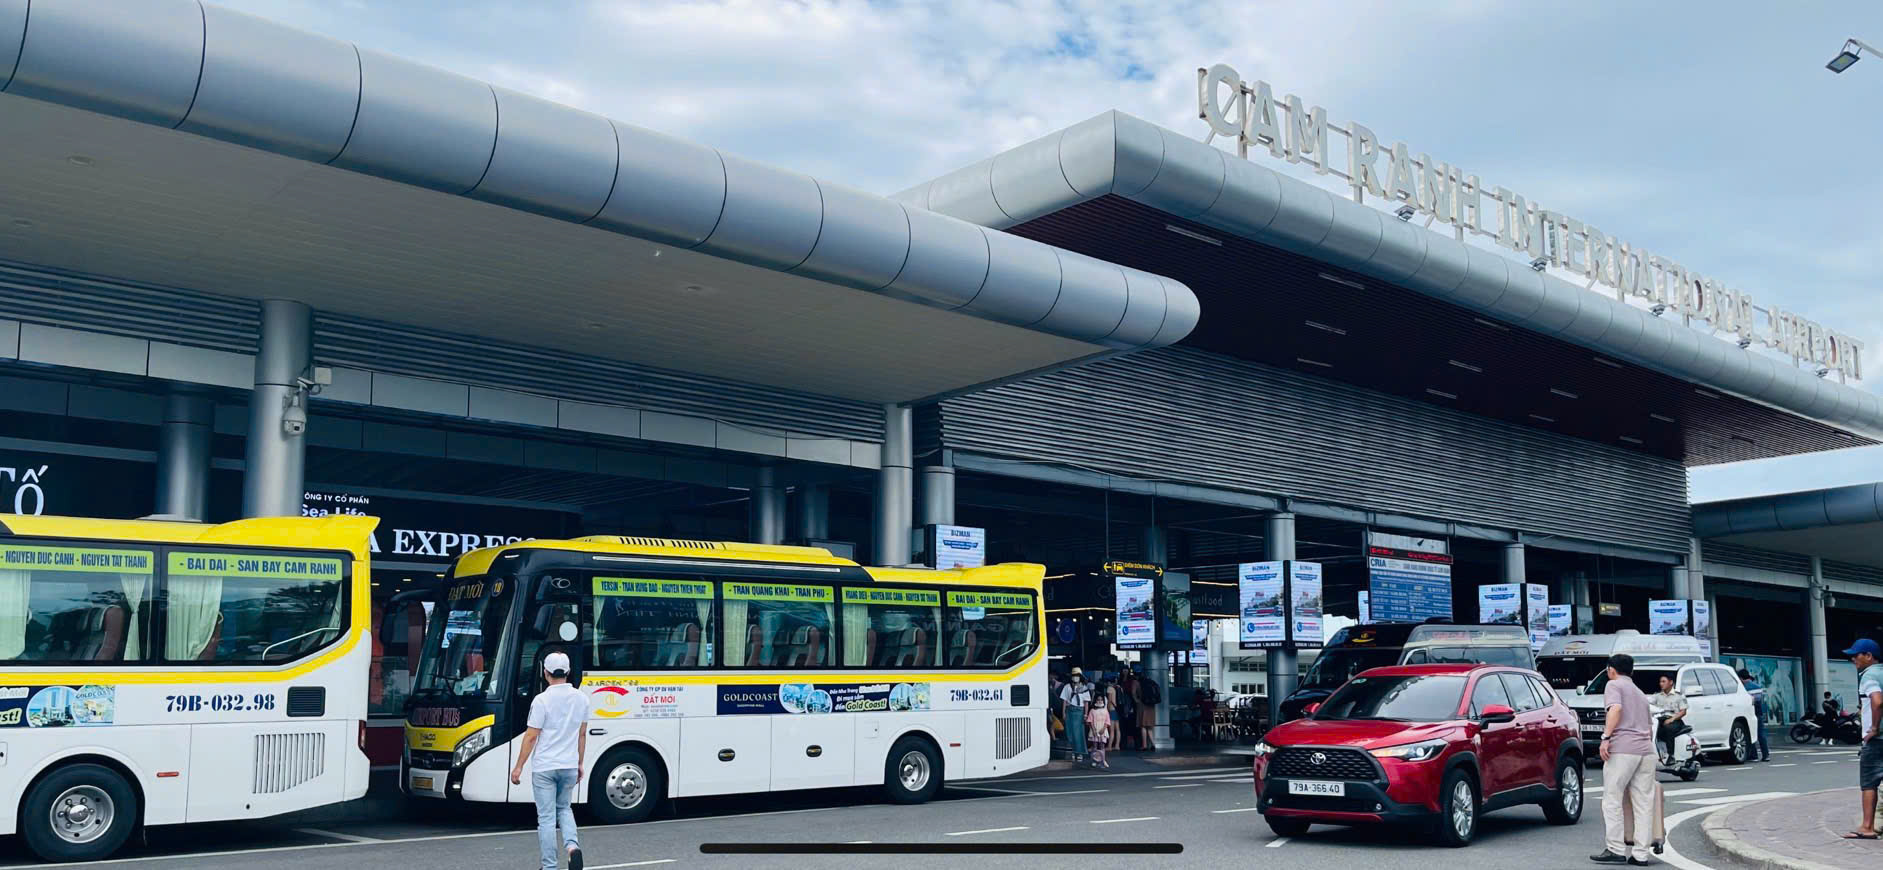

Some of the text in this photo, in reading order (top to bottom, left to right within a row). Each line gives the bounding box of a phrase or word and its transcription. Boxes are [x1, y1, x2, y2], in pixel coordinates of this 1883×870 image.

[1198, 64, 1864, 381] CAM RANH INTERNATIONAL AIRPORT
[304, 492, 322, 501] ÔNG
[302, 504, 328, 517] Sea
[5, 550, 148, 569] NGUYEN DUC CANH NGUYEN TAT THANH
[187, 557, 337, 575] BAI DAI SAN BAY CAM RANH
[733, 585, 825, 598] TRAN QUANG KHAI TRAN PHU
[723, 693, 778, 702] GOLDCOAST
[950, 689, 1003, 702] 79B-032.61
[166, 693, 276, 712] 79B-032.98
[846, 701, 863, 710] Gold
[864, 699, 886, 709] Coast!
[1294, 782, 1340, 793] 79A-366.40
